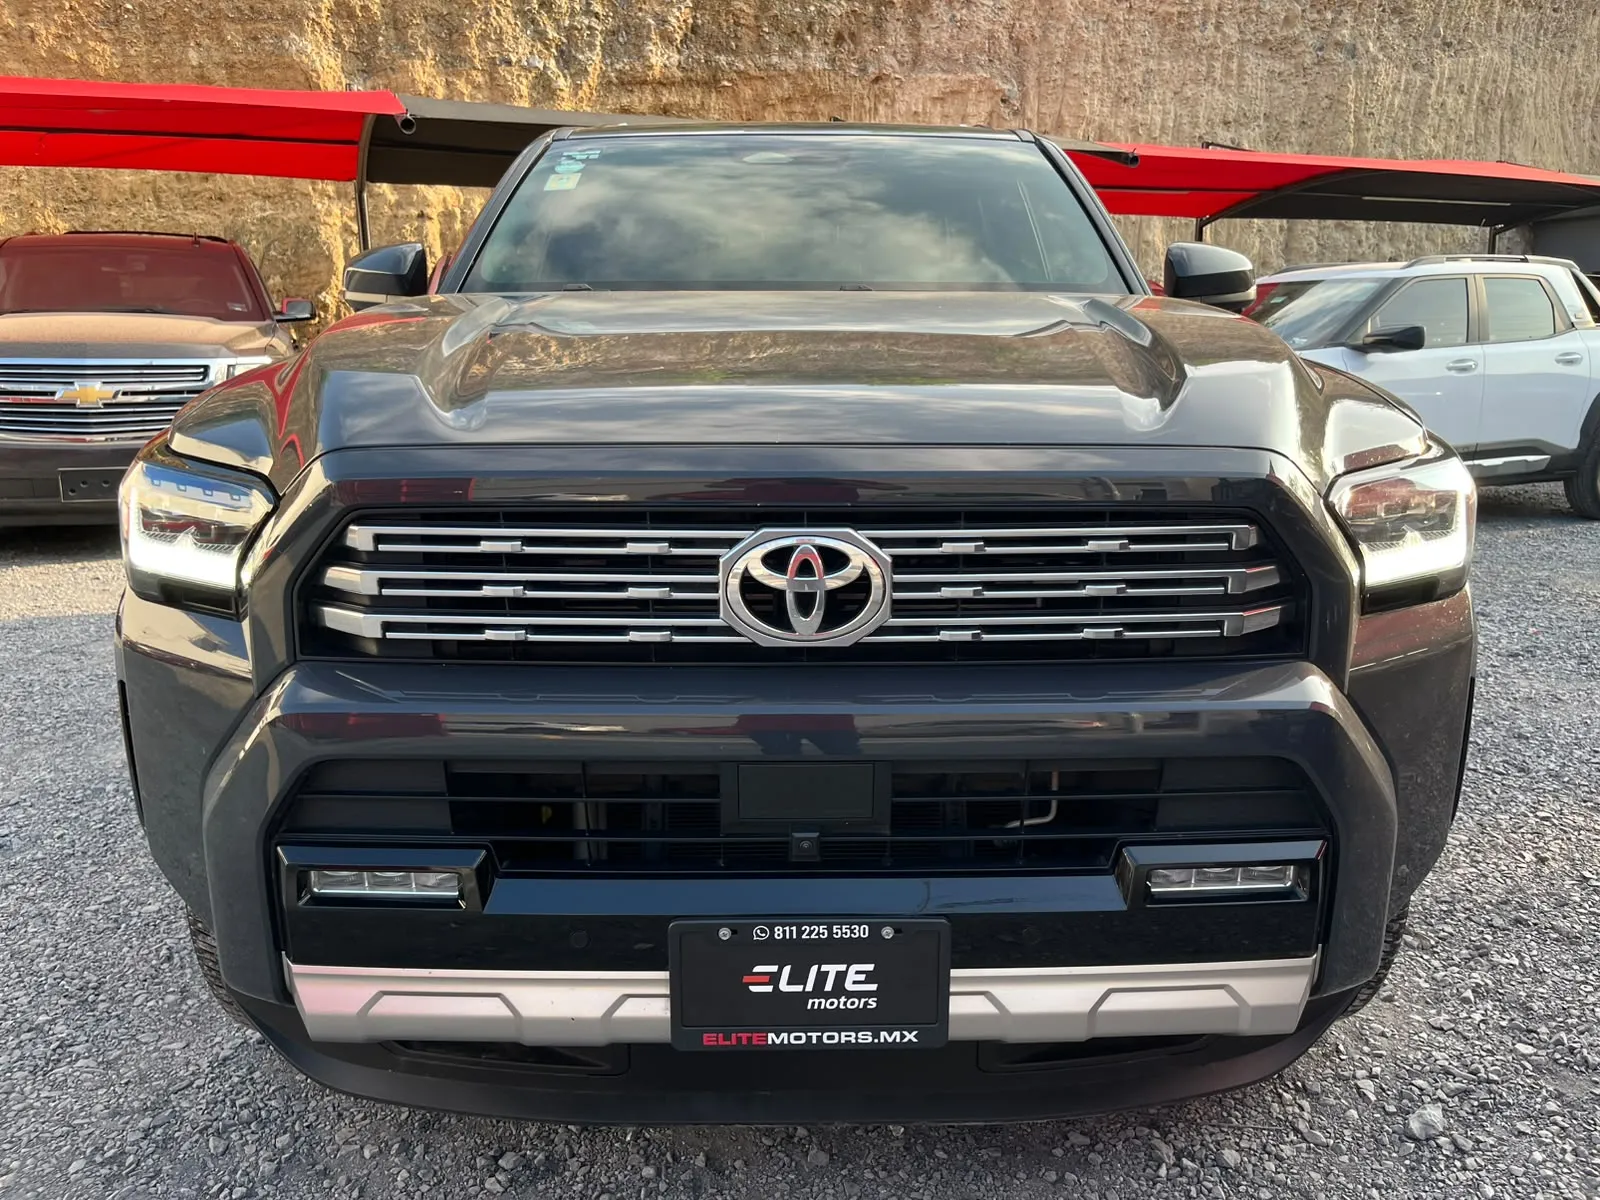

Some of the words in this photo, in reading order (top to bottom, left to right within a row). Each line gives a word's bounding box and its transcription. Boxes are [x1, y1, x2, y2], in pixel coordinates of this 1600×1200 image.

[773, 926, 797, 940] 811
[801, 925, 828, 939] 225
[832, 924, 870, 939] 5530
[742, 963, 879, 993] ELITE
[806, 995, 878, 1010] motors
[702, 1030, 919, 1047] ELITEMOTORS.MX
